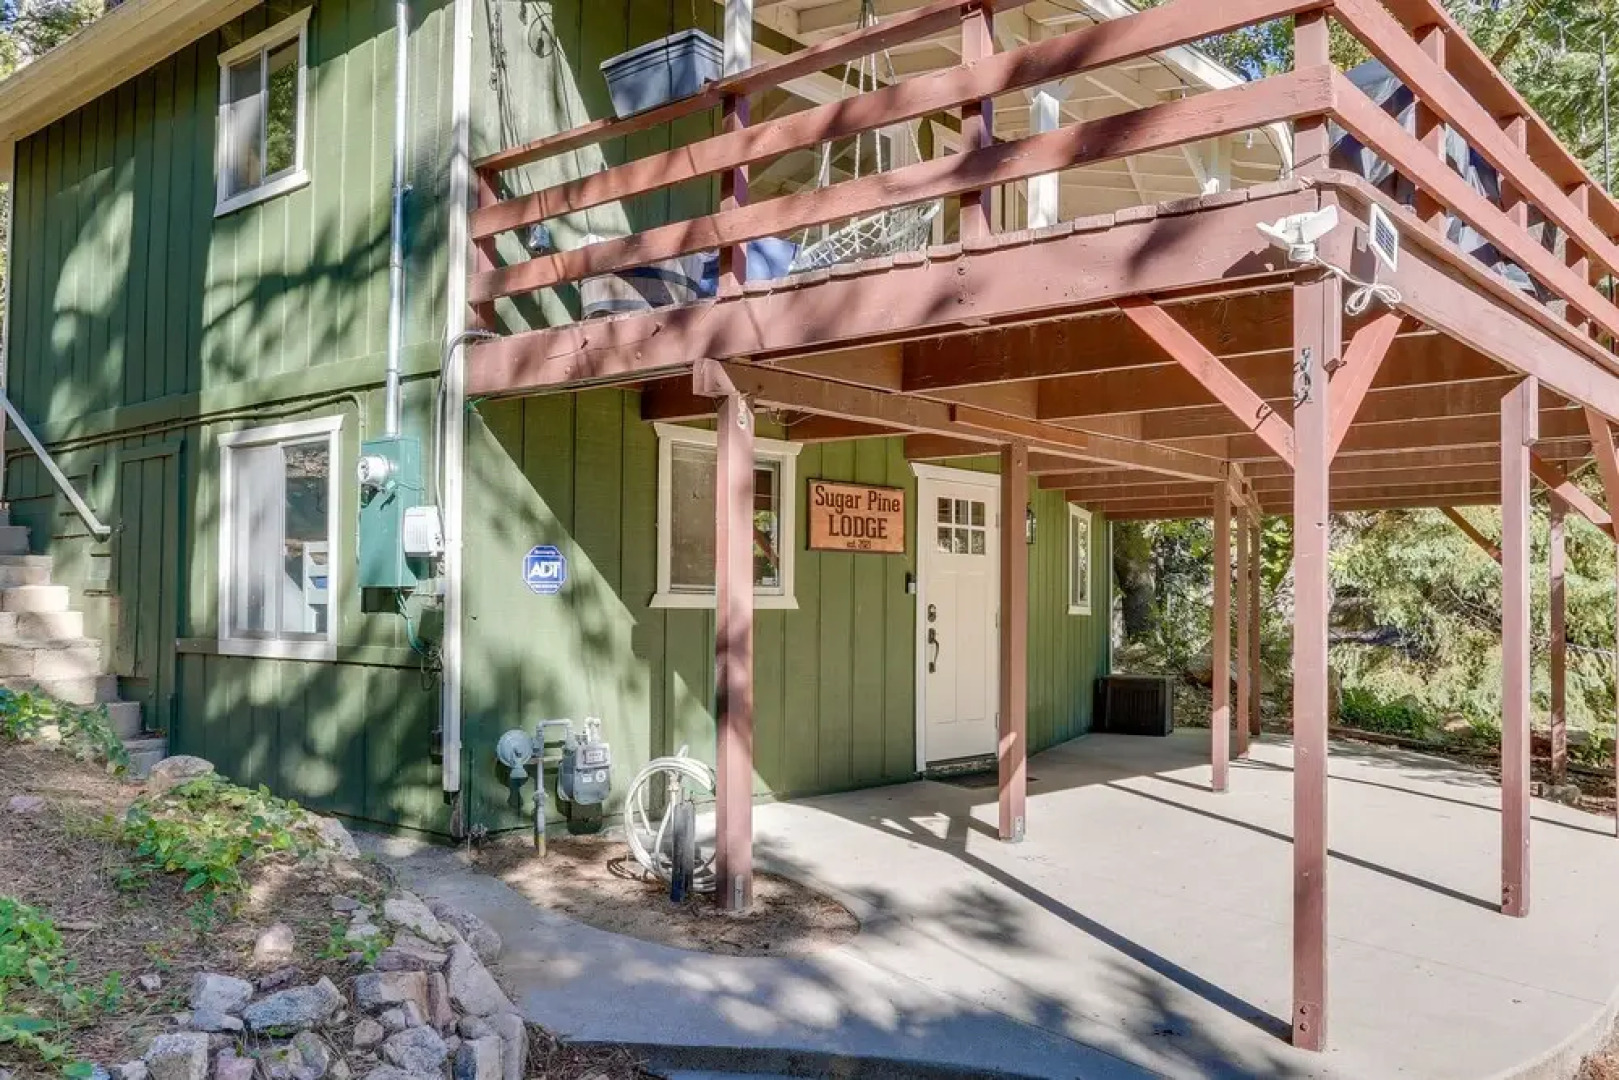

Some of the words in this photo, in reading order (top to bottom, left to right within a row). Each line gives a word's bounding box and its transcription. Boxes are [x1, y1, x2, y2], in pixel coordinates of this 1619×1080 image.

[815, 485, 862, 515] Sugar
[867, 490, 901, 513] Pine
[828, 514, 888, 540] LODGE
[530, 561, 561, 578] ADT
